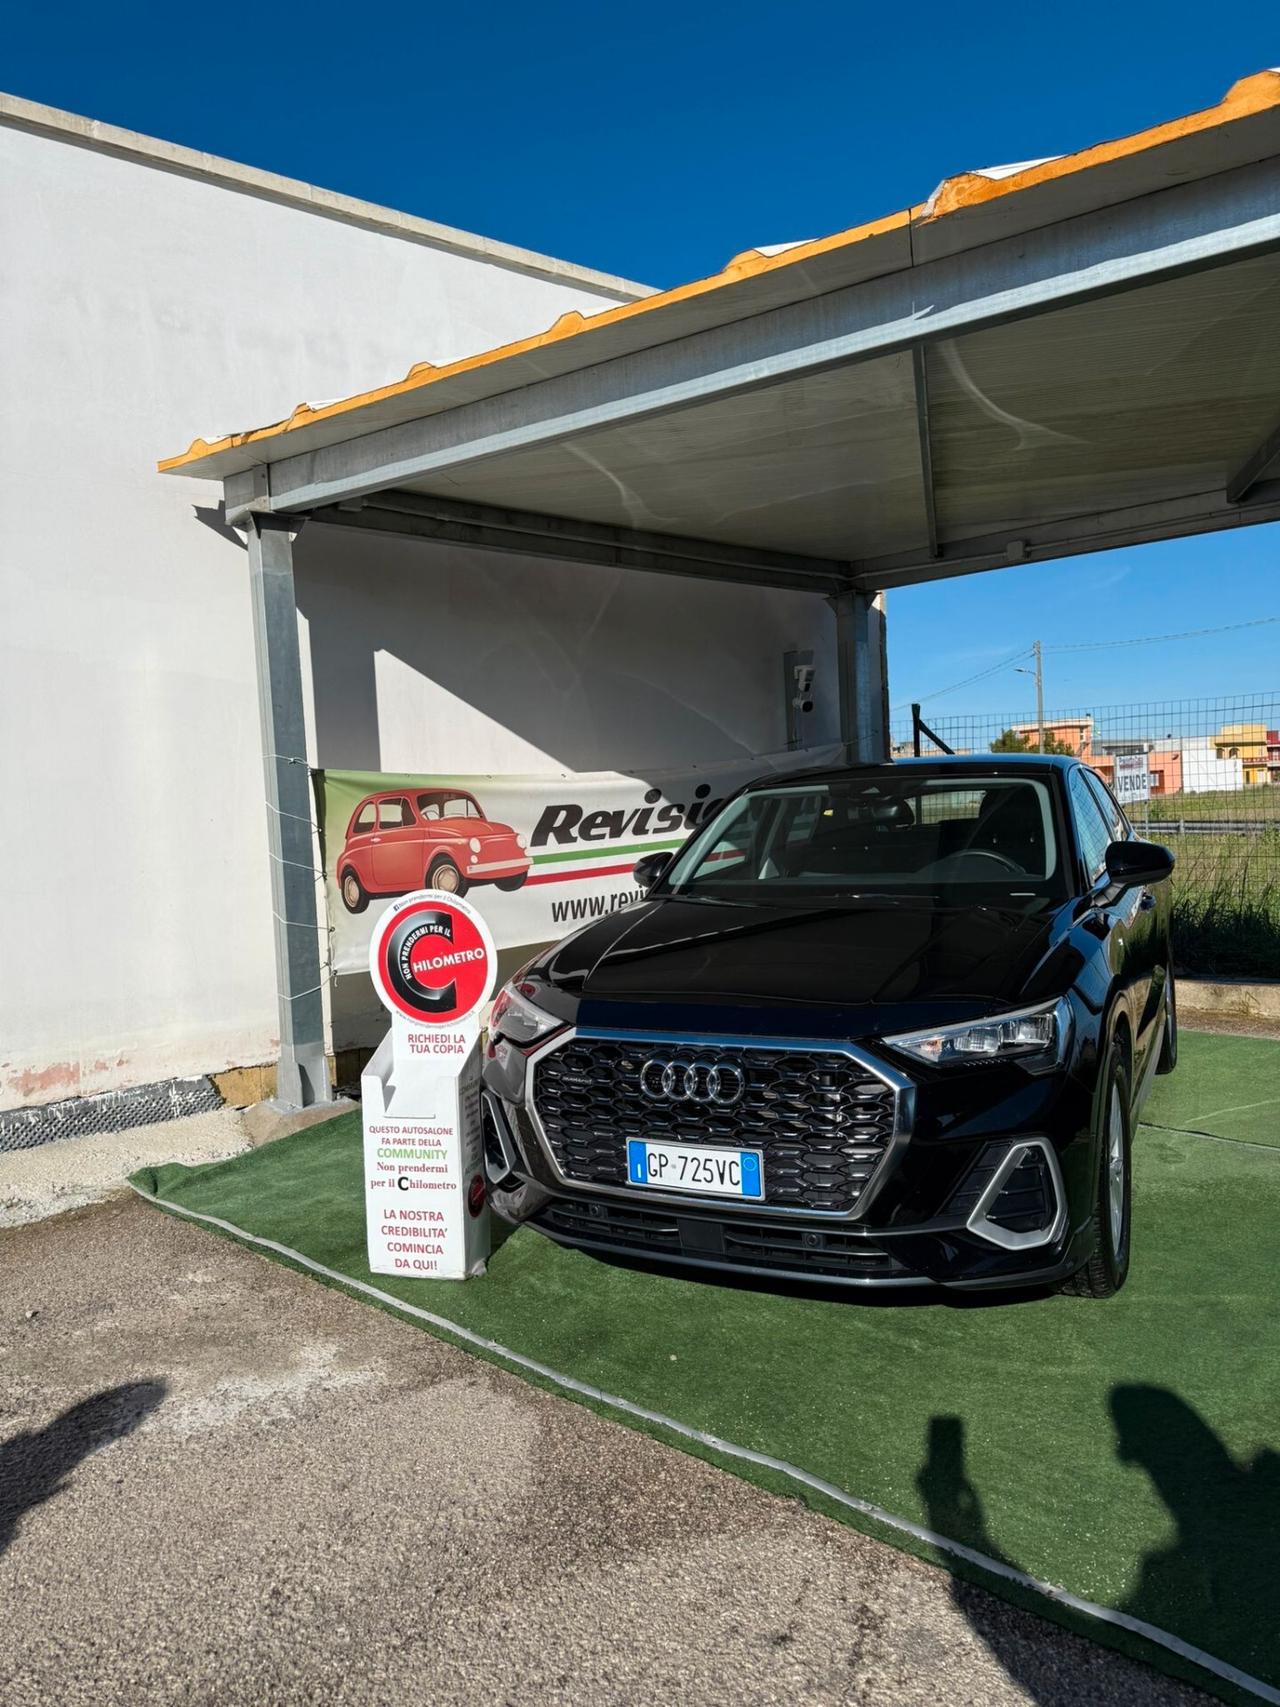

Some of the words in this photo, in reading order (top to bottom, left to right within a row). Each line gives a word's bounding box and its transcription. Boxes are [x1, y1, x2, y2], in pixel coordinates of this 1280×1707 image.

[1118, 773, 1147, 792] VENDE
[429, 925, 444, 933] PER
[444, 927, 451, 937] IL
[401, 925, 429, 961] PRENDERMI
[401, 963, 413, 980] NON
[408, 1033, 450, 1044] RICHIEDI
[453, 1034, 466, 1044] LA
[410, 1044, 431, 1054] TUA
[433, 1044, 464, 1054] COPIA
[369, 1125, 400, 1134] QUESTO
[402, 1126, 453, 1135] AUTOSALONE
[381, 1137, 392, 1145] FA
[392, 1137, 416, 1146] PARTE
[418, 1138, 442, 1147] DELLA
[377, 1147, 448, 1160] COMMUNITY
[377, 1161, 395, 1172] Non
[398, 1163, 448, 1174] prendermi
[370, 1179, 386, 1190] per
[388, 1178, 395, 1188] il
[384, 1209, 397, 1220] LA
[399, 1210, 444, 1222] NOSTRA
[387, 1242, 444, 1255] COMINCIA
[394, 1258, 410, 1268] DA
[413, 1259, 438, 1271] QUI!
